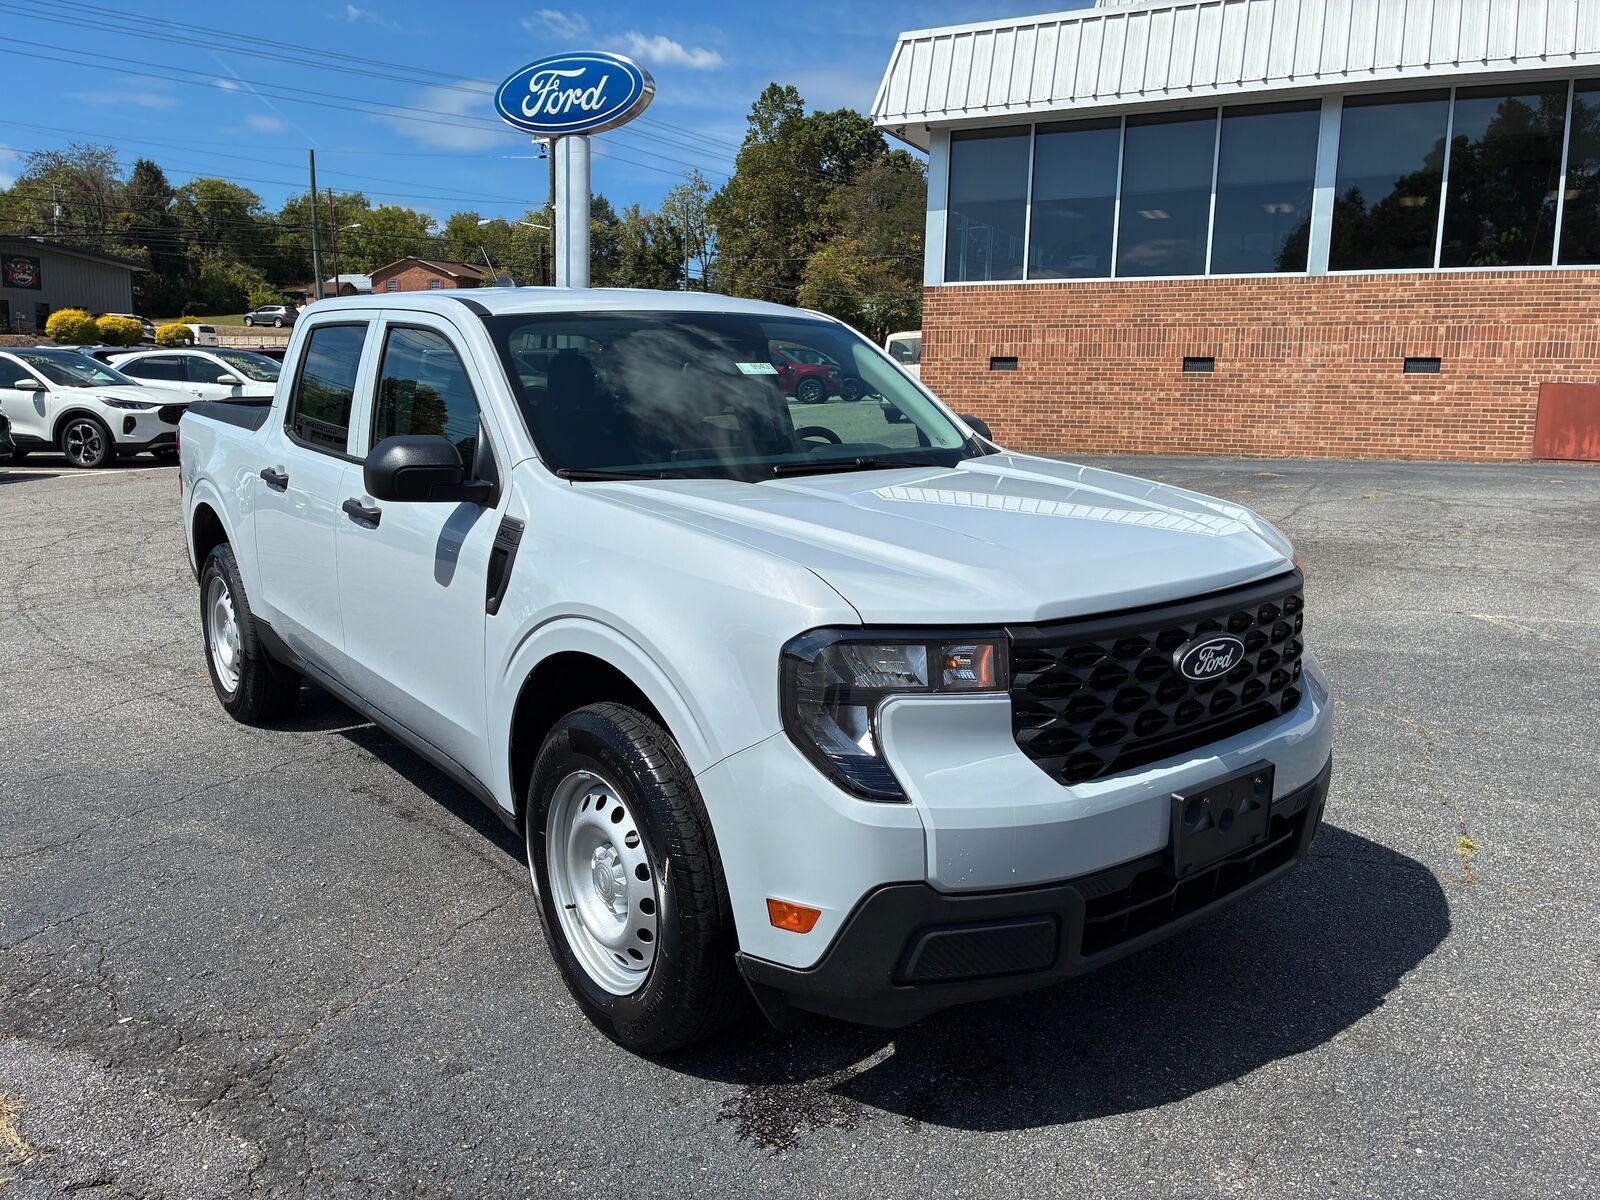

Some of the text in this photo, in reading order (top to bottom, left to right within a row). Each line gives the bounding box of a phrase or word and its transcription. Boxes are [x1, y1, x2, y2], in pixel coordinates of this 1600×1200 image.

[521, 67, 609, 117] Ford
[499, 529, 513, 541] XL
[1194, 644, 1234, 675] Ford
